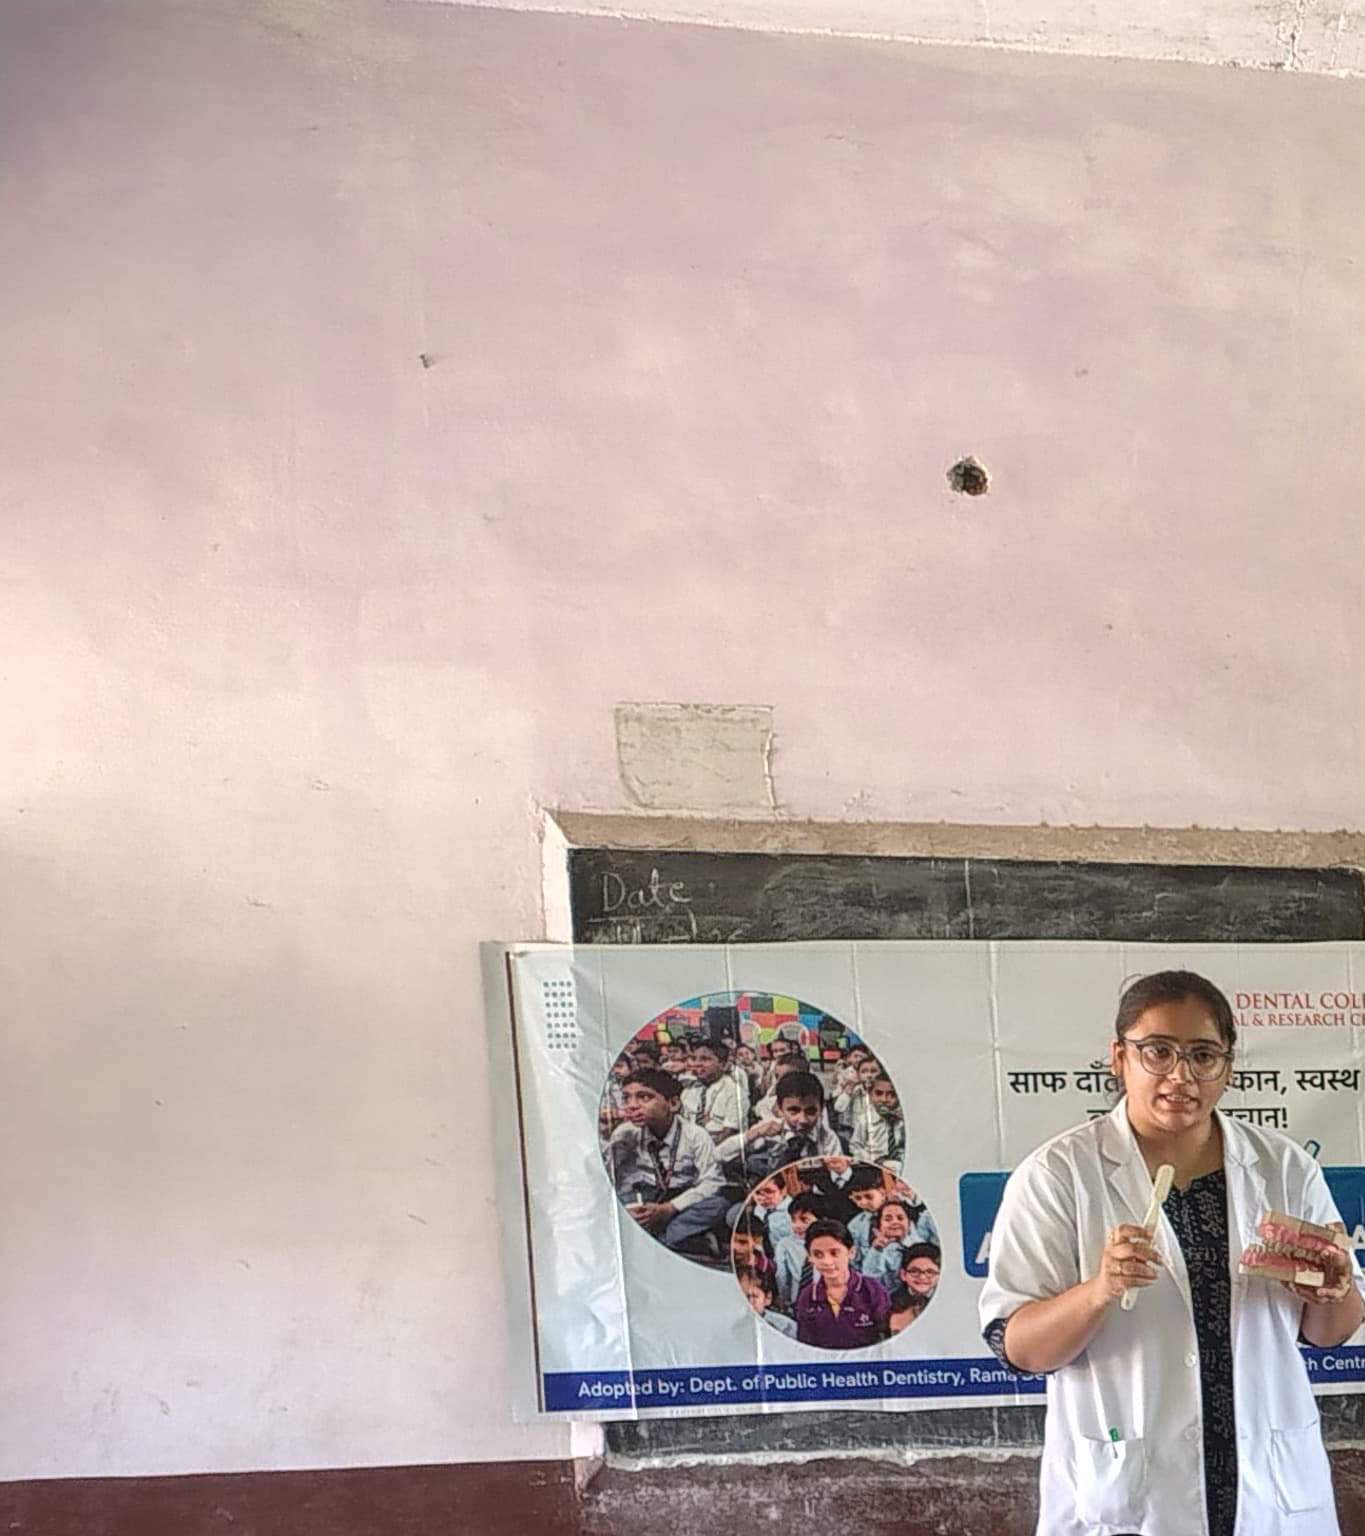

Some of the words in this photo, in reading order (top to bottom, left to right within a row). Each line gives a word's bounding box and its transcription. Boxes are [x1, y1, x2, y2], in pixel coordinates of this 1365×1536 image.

[602, 867, 691, 912] Date
[1236, 993, 1315, 1010] DENTAL
[1252, 1014, 1263, 1026] &
[1268, 1013, 1345, 1026] RESEARCH
[1008, 1071, 1067, 1093] साफ
[1293, 1069, 1360, 1091] स्वस्थ
[578, 1378, 653, 1401] Adopted
[657, 1377, 686, 1396] by:
[689, 1374, 739, 1395] Dept.
[742, 1373, 761, 1391] of
[764, 1371, 817, 1390] Public
[822, 1369, 879, 1389] Health
[883, 1367, 966, 1388] Dentistry,
